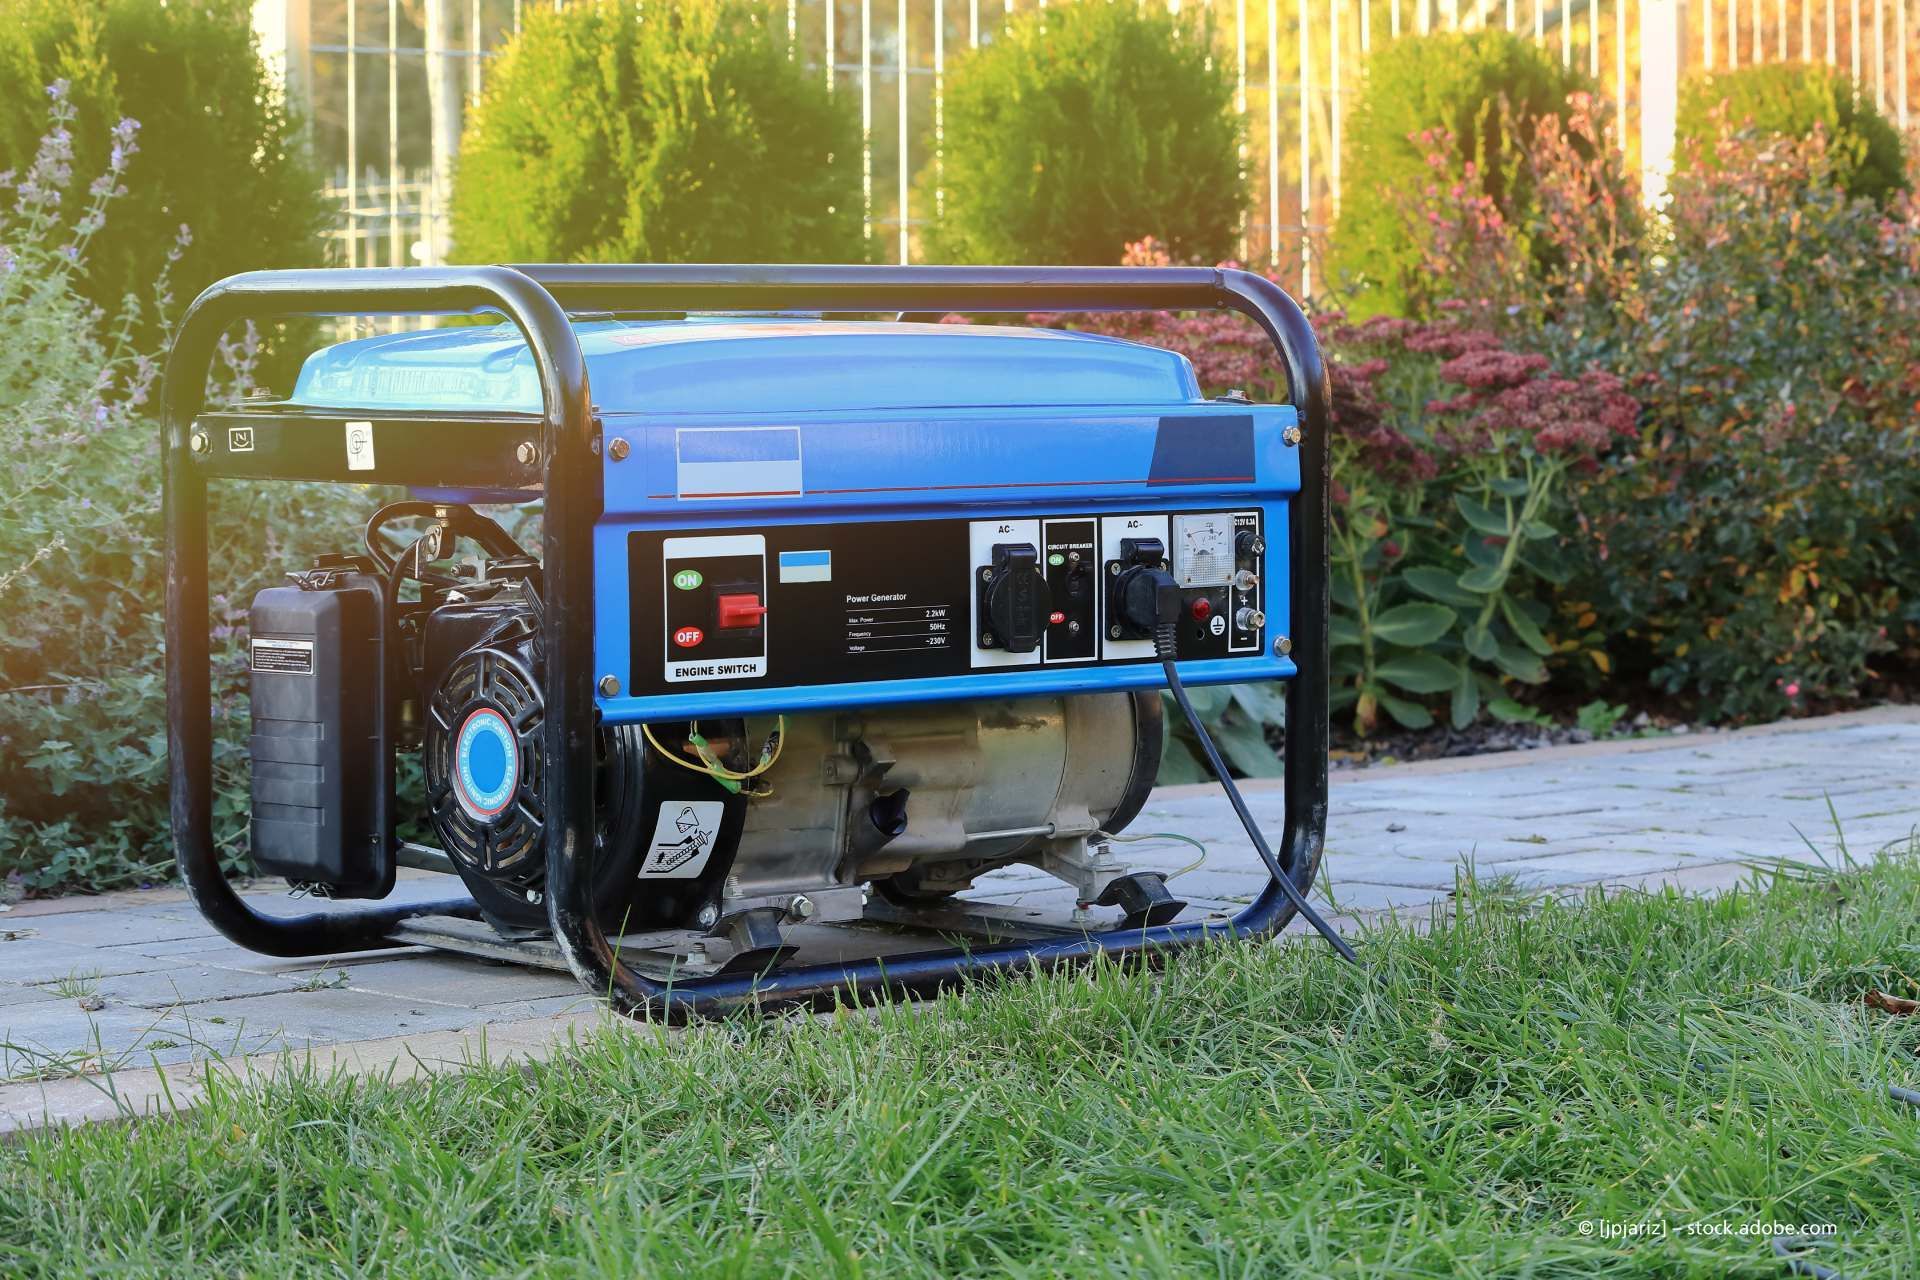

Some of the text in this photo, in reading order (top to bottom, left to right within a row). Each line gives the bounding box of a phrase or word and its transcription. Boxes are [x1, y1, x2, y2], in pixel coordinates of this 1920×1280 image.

[677, 575, 698, 587] ON
[846, 593, 907, 603] Power Generator
[925, 609, 946, 618] 2.2kW
[1050, 613, 1064, 621] OFF
[929, 623, 946, 631] 50Hz
[677, 631, 700, 643] OFF
[675, 663, 757, 677] ENGINE SWITCH
[462, 717, 513, 758] ELECTRONIC IGNITION
[461, 766, 513, 806] ELECTRONIC IGNITION
